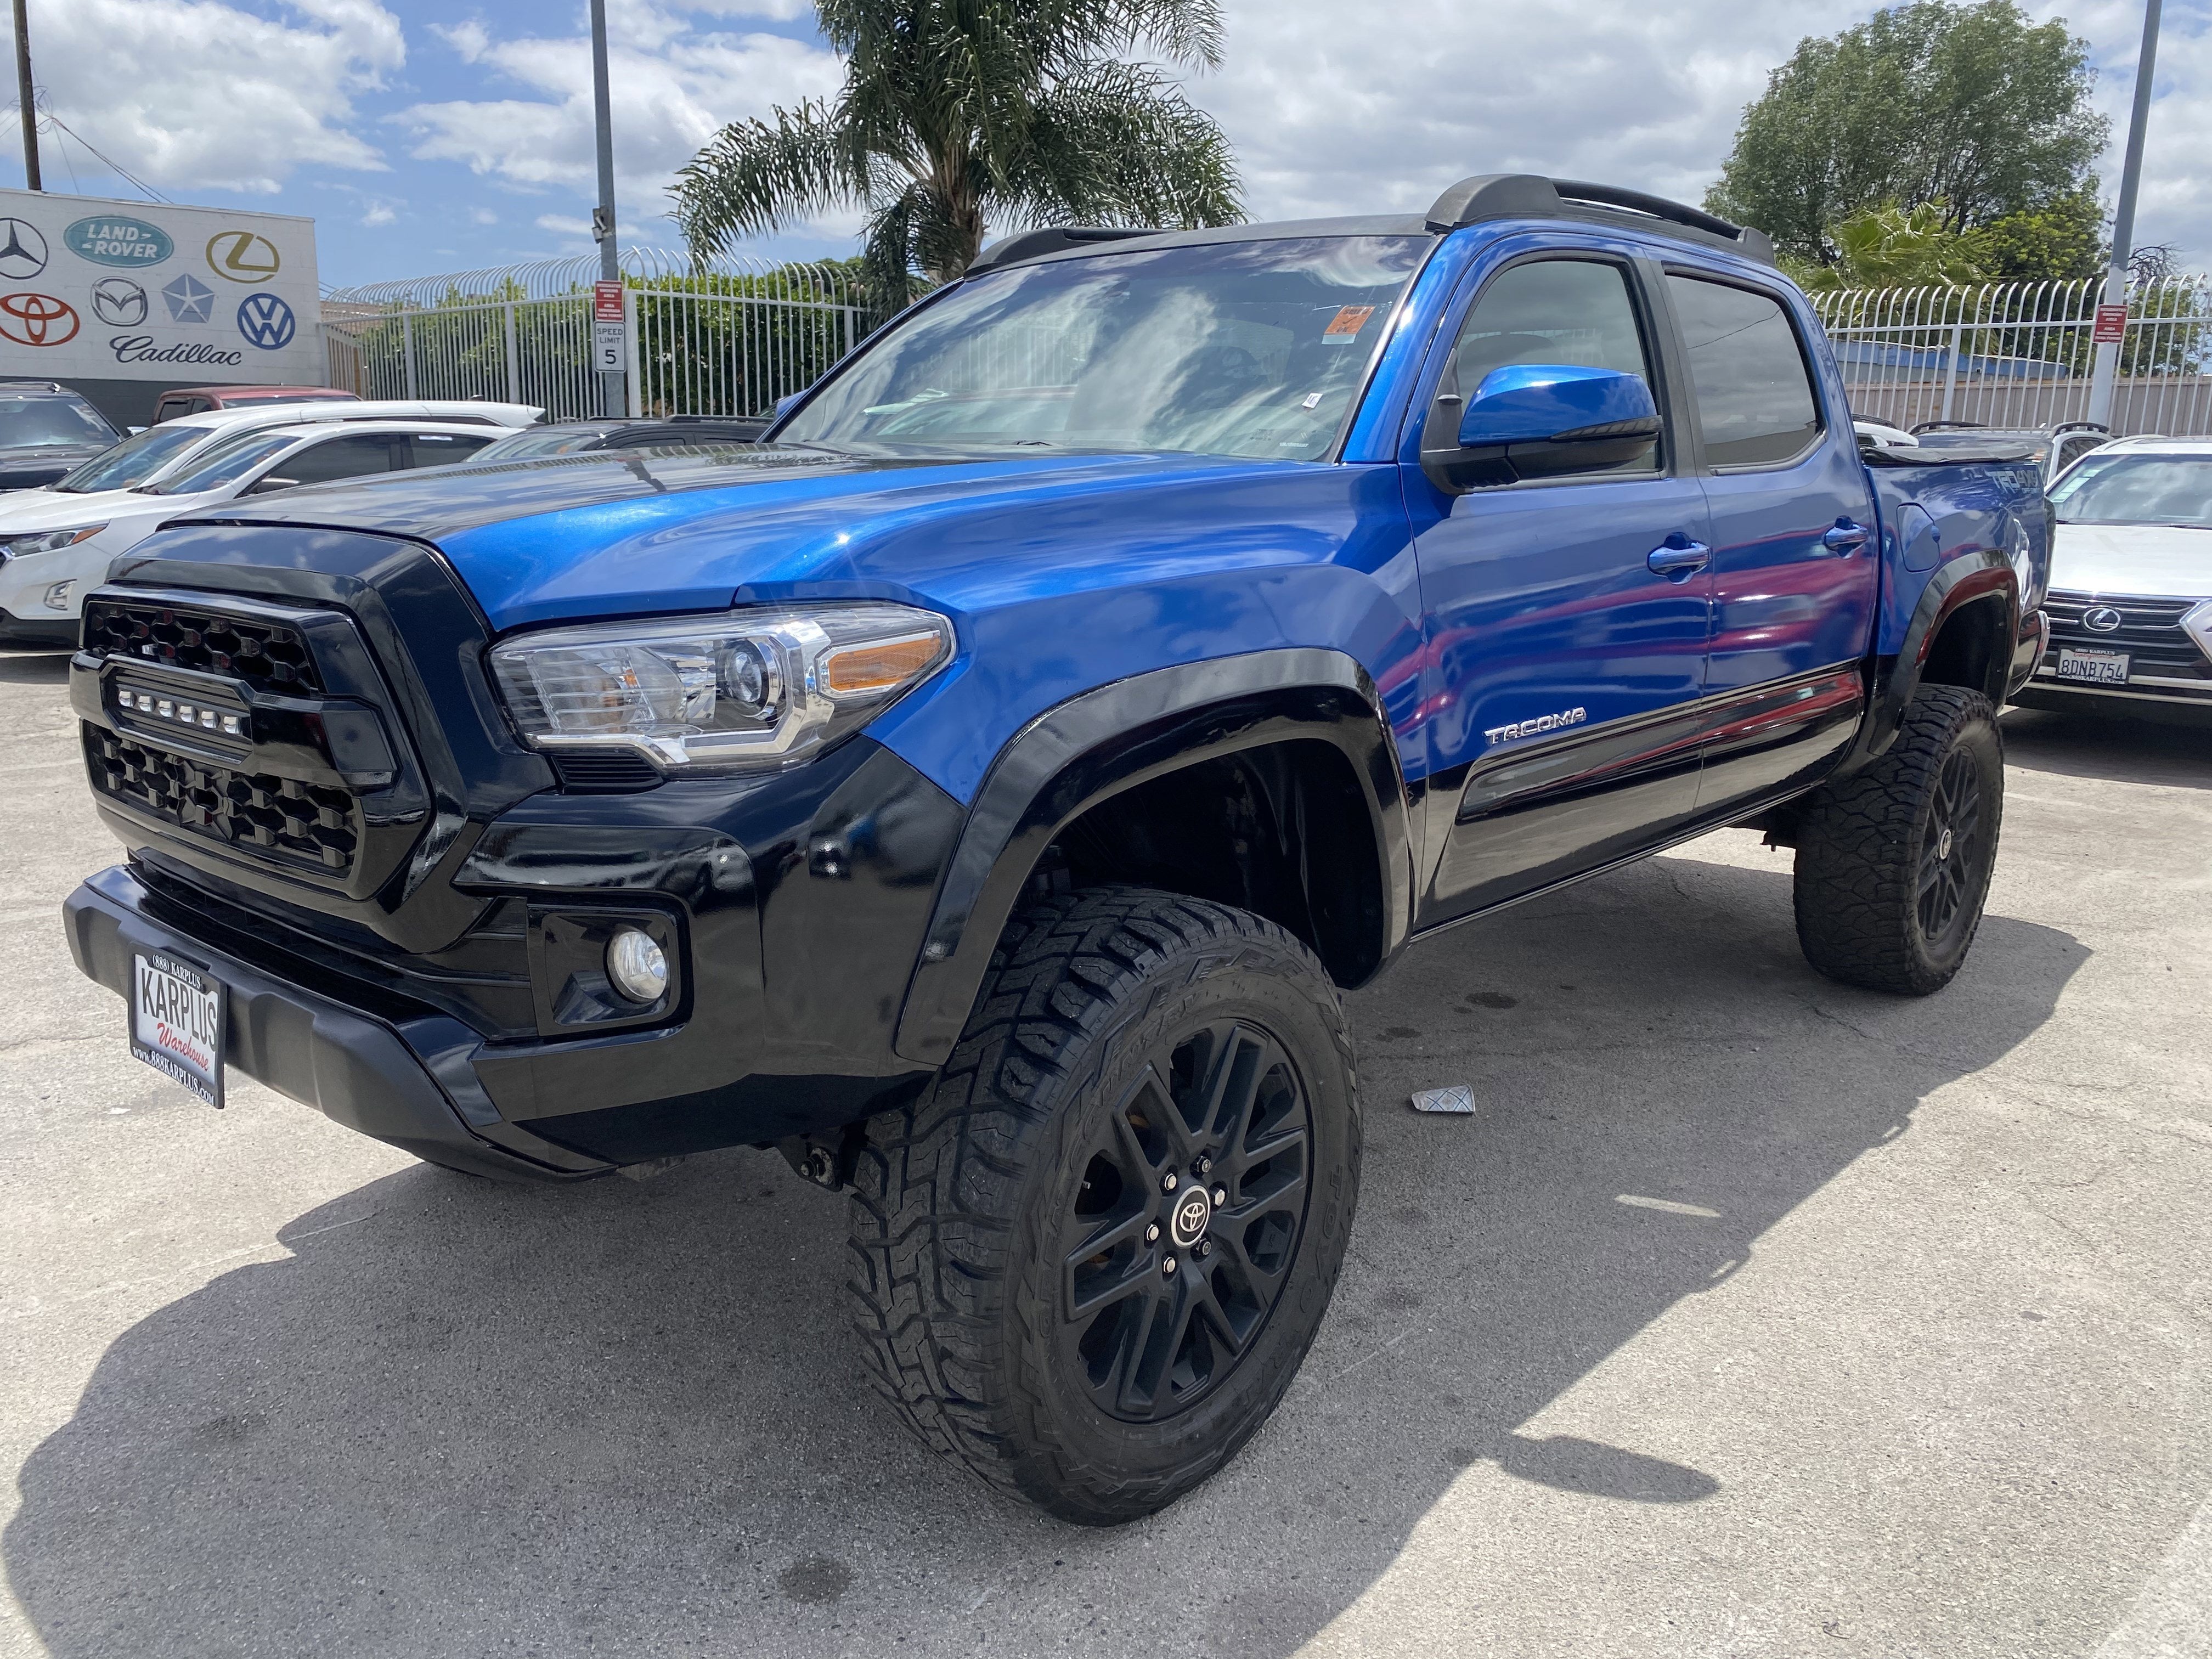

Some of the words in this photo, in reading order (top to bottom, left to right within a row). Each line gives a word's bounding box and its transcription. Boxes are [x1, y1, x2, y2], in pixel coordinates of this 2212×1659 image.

[87, 224, 139, 240] LAND
[94, 242, 157, 258] ROVER
[110, 336, 241, 365] Cadillac
[605, 349, 616, 364] 5
[2061, 659, 2123, 680] 8DNB754
[1483, 707, 1587, 746] TACOMA
[152, 953, 170, 972] (888)
[171, 961, 201, 988] KARPLUS
[142, 967, 216, 1052] KARPLUS
[157, 1023, 209, 1071] Warehouse
